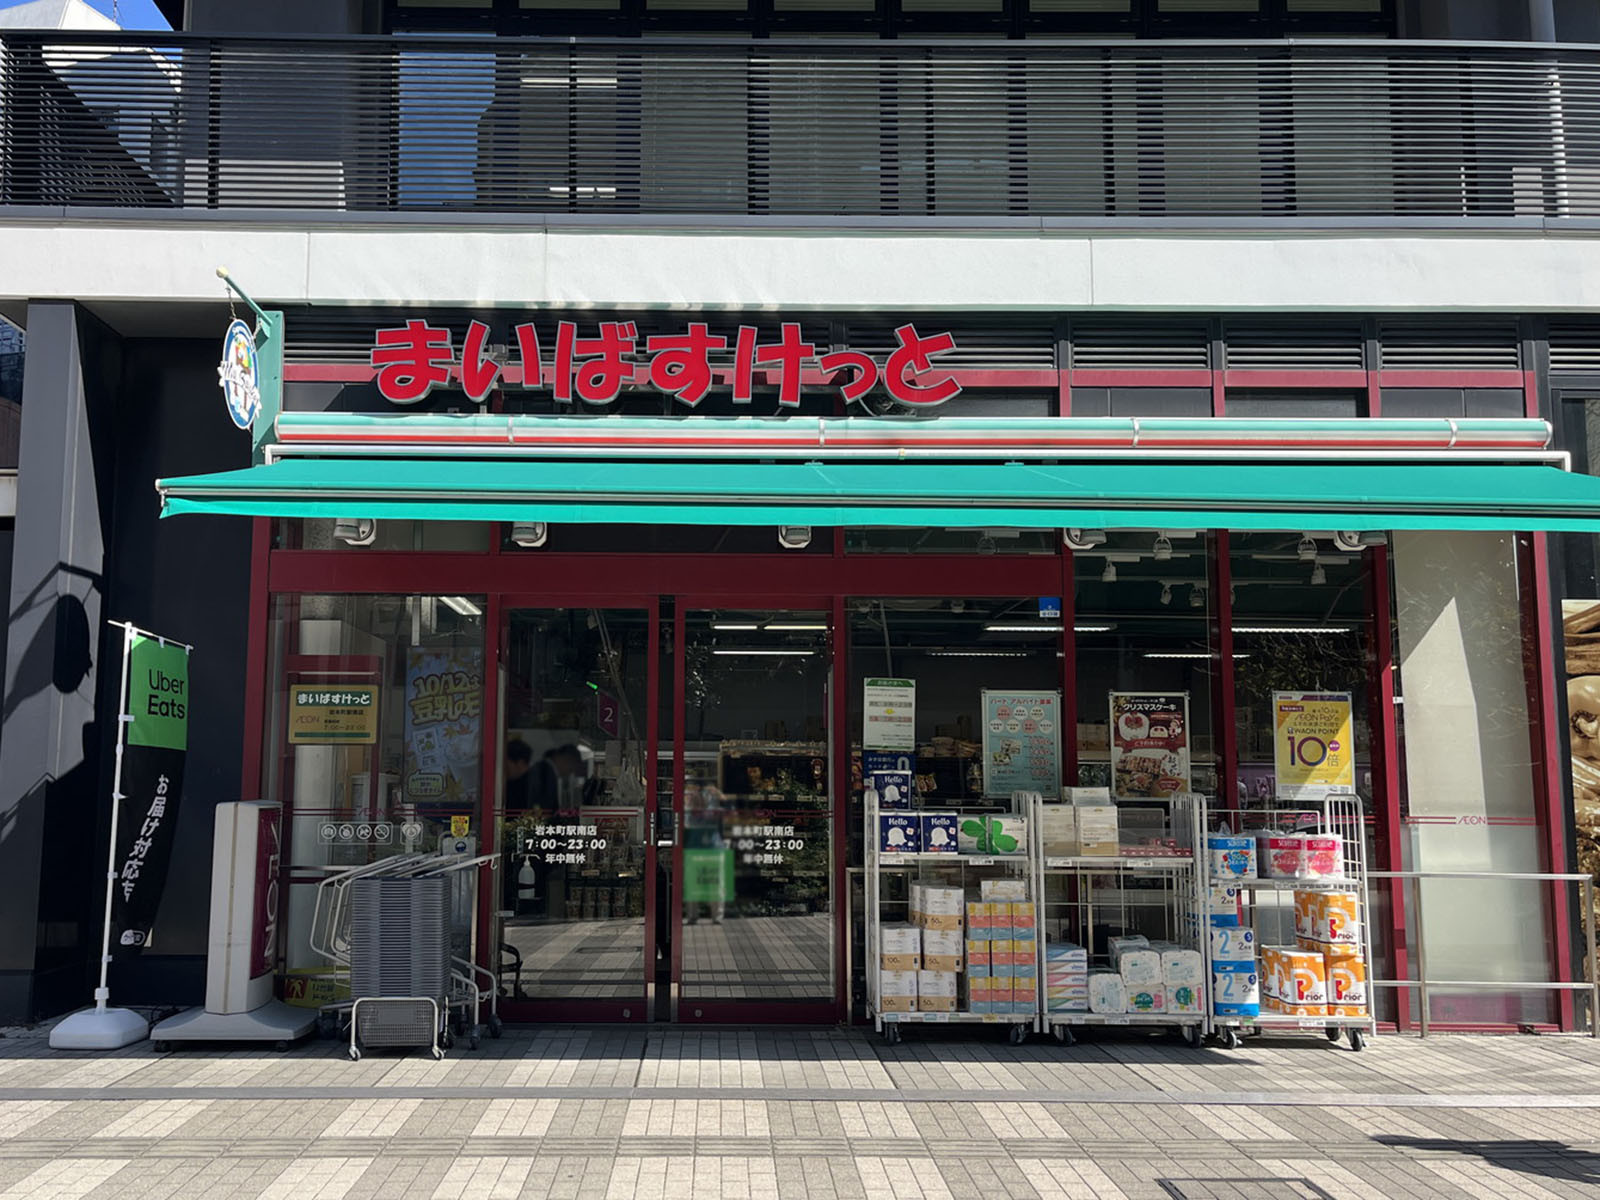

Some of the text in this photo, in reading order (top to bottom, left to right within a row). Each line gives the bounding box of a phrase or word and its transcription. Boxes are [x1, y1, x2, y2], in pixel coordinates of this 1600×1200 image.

[369, 317, 963, 408] まいばすけっと
[148, 668, 185, 695] Uber
[297, 692, 370, 704] まいばすけっと
[147, 694, 186, 719] Eats
[1122, 703, 1177, 711] クリスマスケーキ
[603, 706, 614, 723] 2
[1287, 736, 1328, 767] 10
[884, 775, 903, 784] Hello
[888, 817, 908, 826] Hello
[931, 817, 951, 826] Hello
[535, 825, 598, 837] 岩本町駅南店
[545, 853, 586, 865] 年中無休
[1293, 973, 1324, 1001] Prior
[1332, 973, 1363, 1001] Prior
